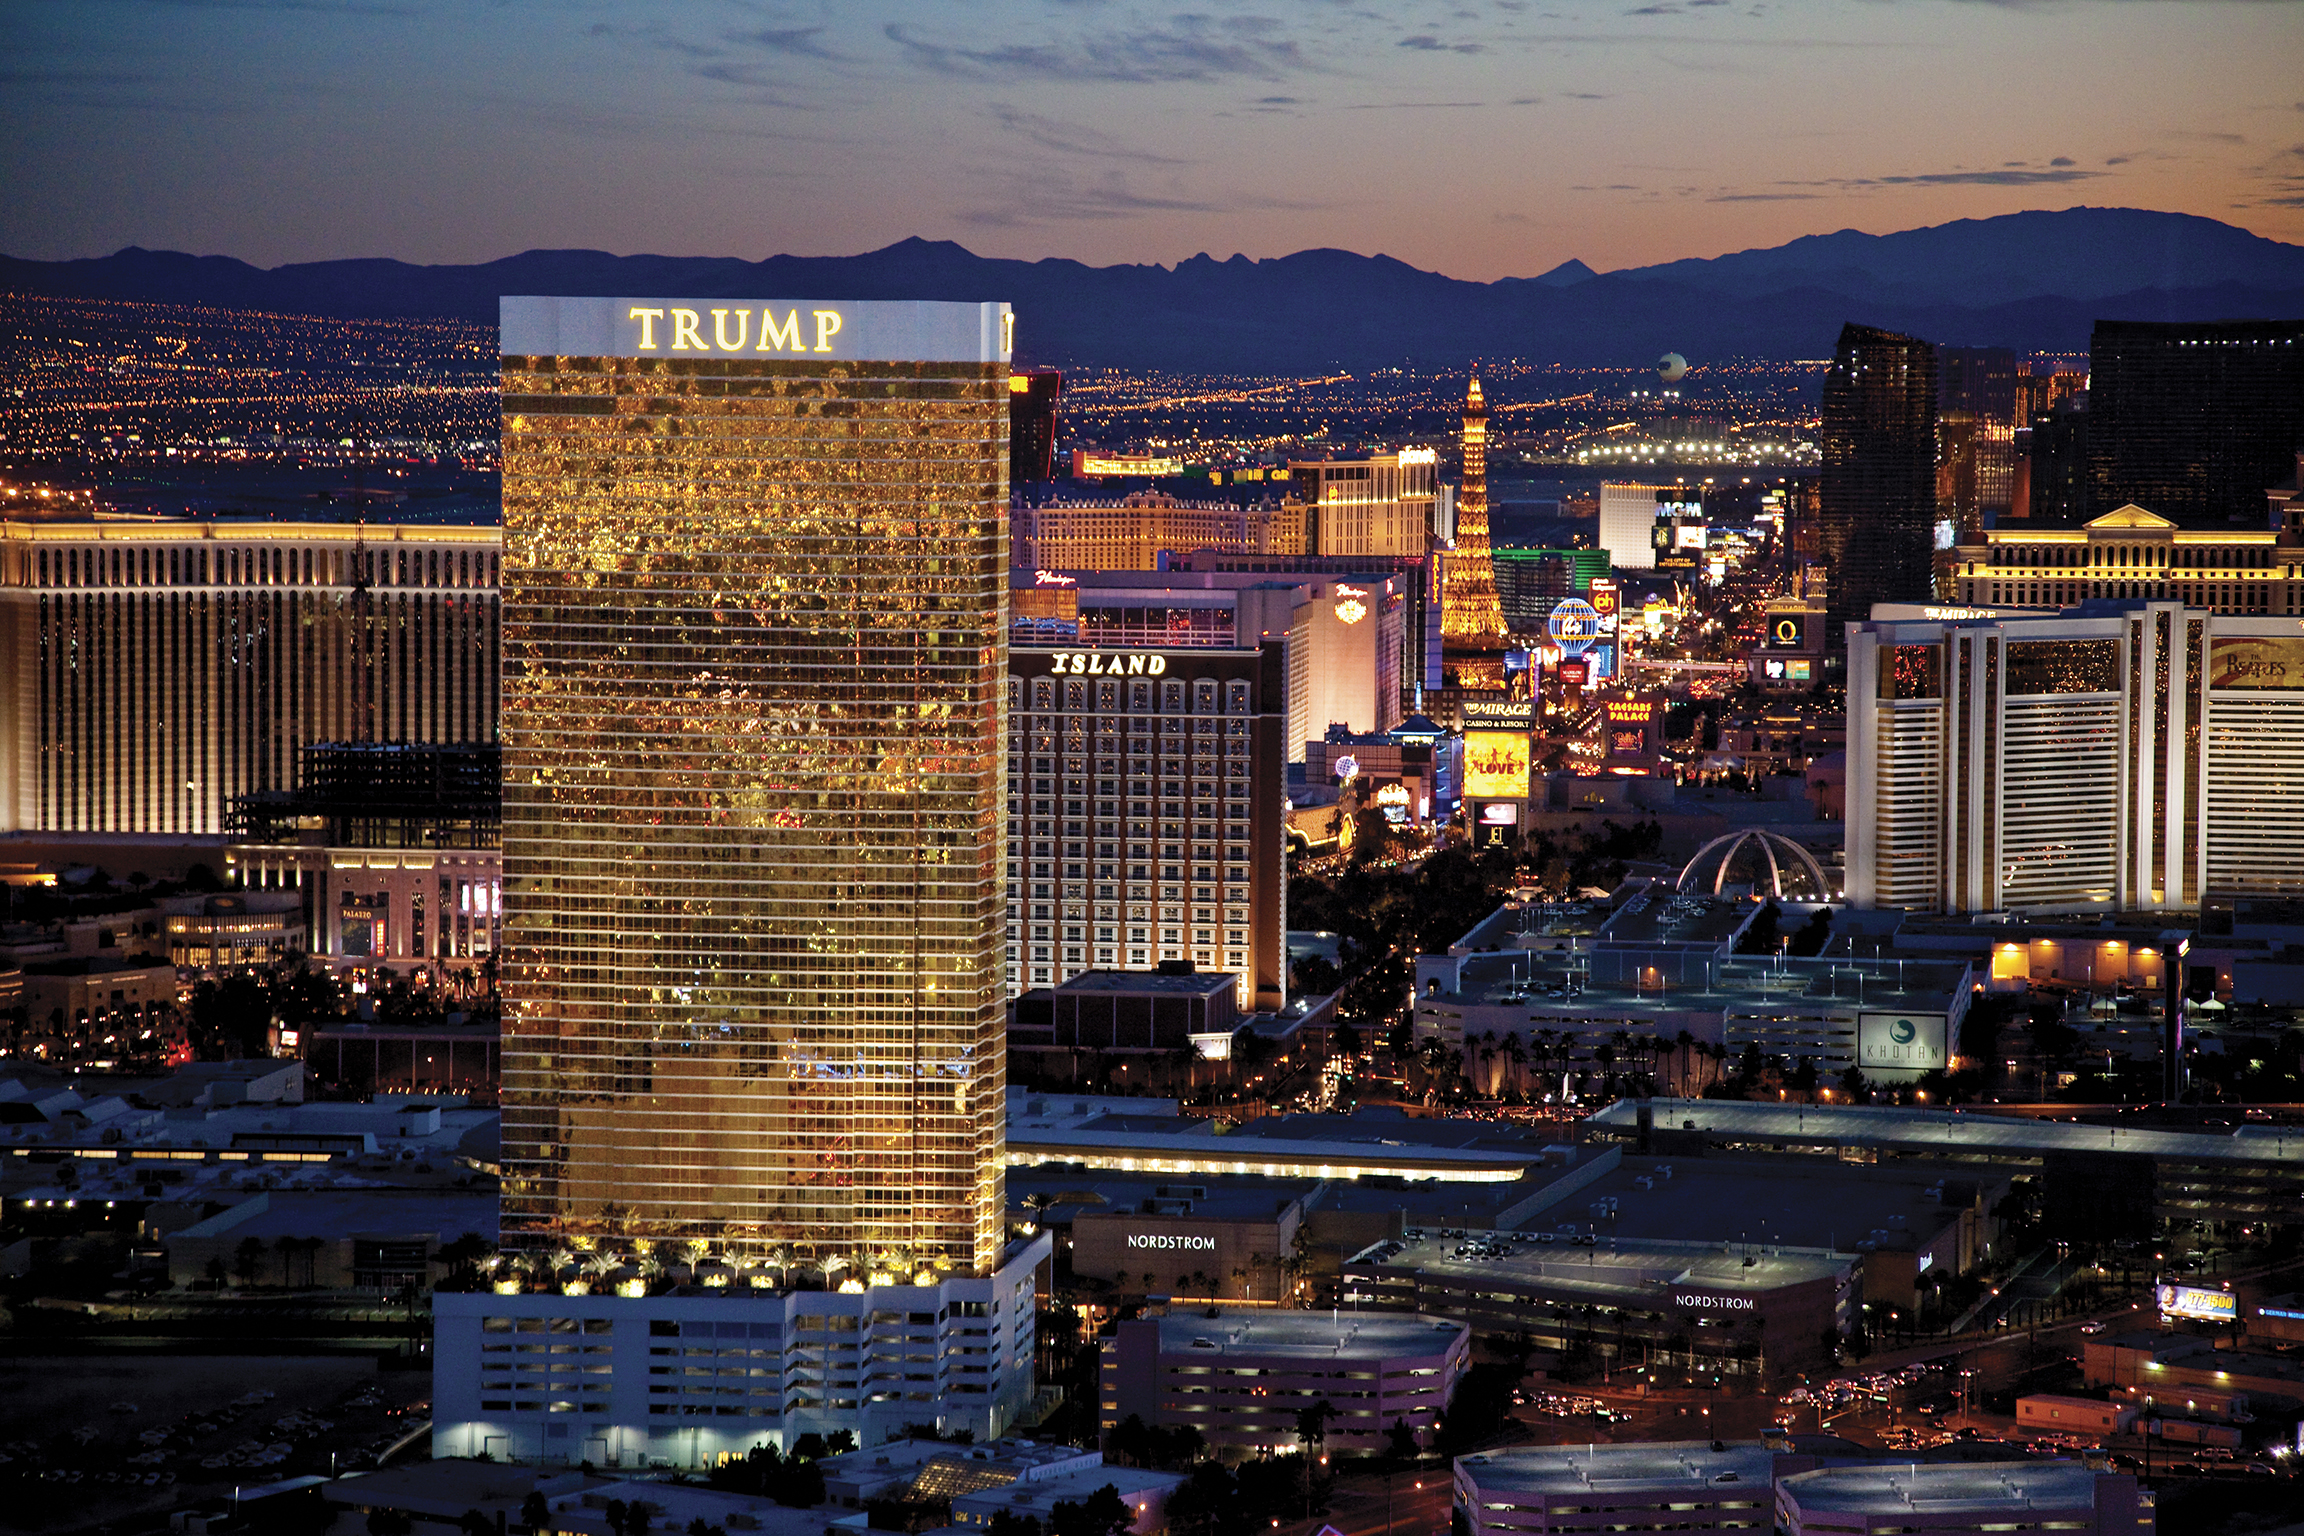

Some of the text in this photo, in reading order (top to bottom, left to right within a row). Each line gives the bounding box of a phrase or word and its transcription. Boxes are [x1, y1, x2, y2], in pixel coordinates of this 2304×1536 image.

[629, 306, 842, 352] TRUMP
[1655, 501, 1702, 517] MGM
[1034, 568, 1076, 587] Flamingo
[1051, 653, 1166, 675] ISLAND
[2226, 653, 2286, 678] BEATLES
[1474, 703, 1532, 717] MIRAGE
[1607, 702, 1652, 712] CAESARS
[1466, 720, 1493, 728] CASINO
[1500, 720, 1530, 728] RESORT
[1609, 711, 1650, 721] PALACE
[1479, 763, 1515, 775] LOVE
[1488, 826, 1504, 843] JET
[343, 910, 372, 919] PALAZZO
[1867, 1045, 1939, 1060] KHOTAN
[1128, 1234, 1215, 1250] NORDSTROM
[1676, 1294, 1754, 1310] NORDSTROM
